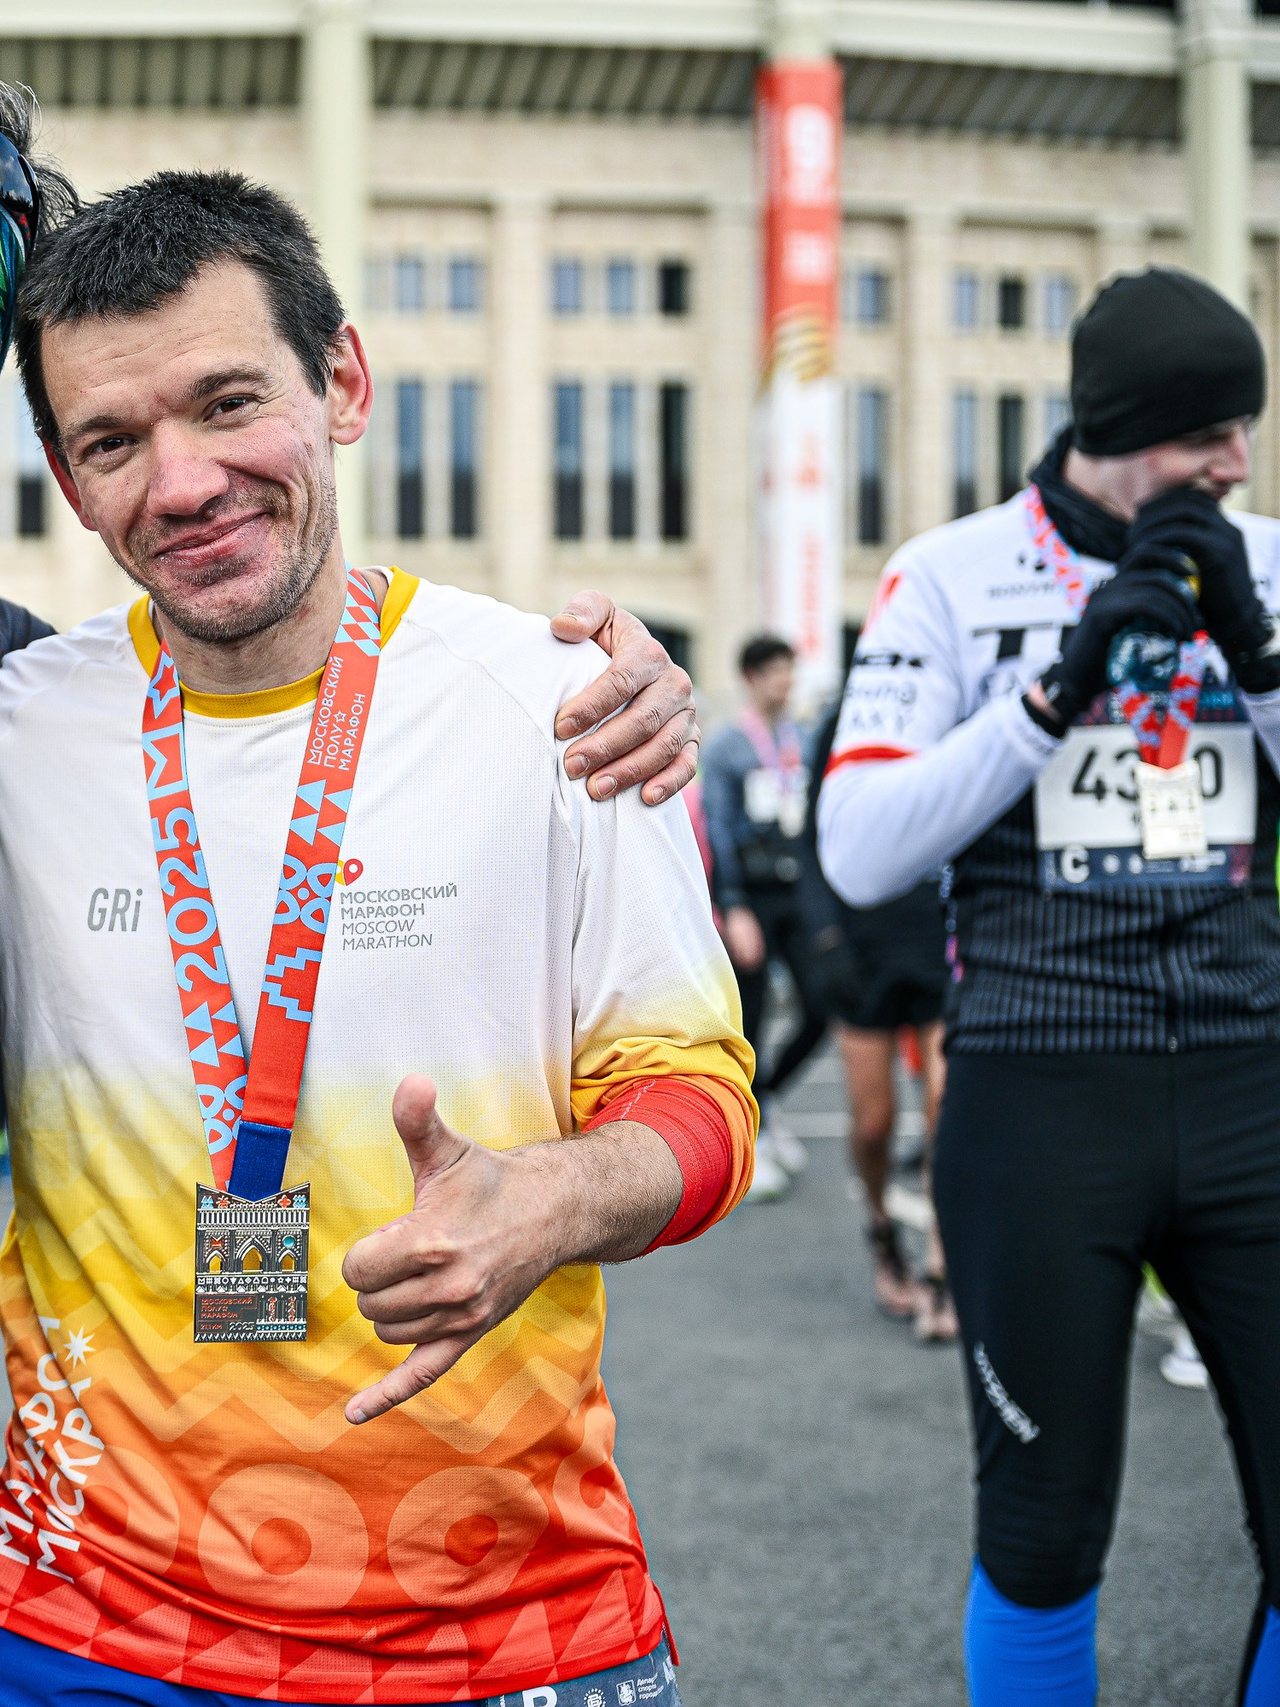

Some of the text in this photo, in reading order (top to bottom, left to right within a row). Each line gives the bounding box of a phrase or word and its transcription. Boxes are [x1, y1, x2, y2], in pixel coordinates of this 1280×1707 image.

[306, 655, 345, 766] МОСКОВСКИЙ
[337, 692, 366, 771] МАРАФОН
[324, 720, 345, 769] ПОЛУ
[1072, 742, 1225, 804] 430
[1060, 843, 1091, 885] C
[87, 888, 144, 932] GRi
[153, 806, 229, 991] 2025
[340, 882, 458, 904] МОСКОВСКИЙ
[341, 903, 425, 921] МАРАФОН
[342, 919, 415, 936] MOSCOW
[342, 934, 433, 951] MARATHON
[201, 1297, 253, 1305] МОСКОВСКИЙ
